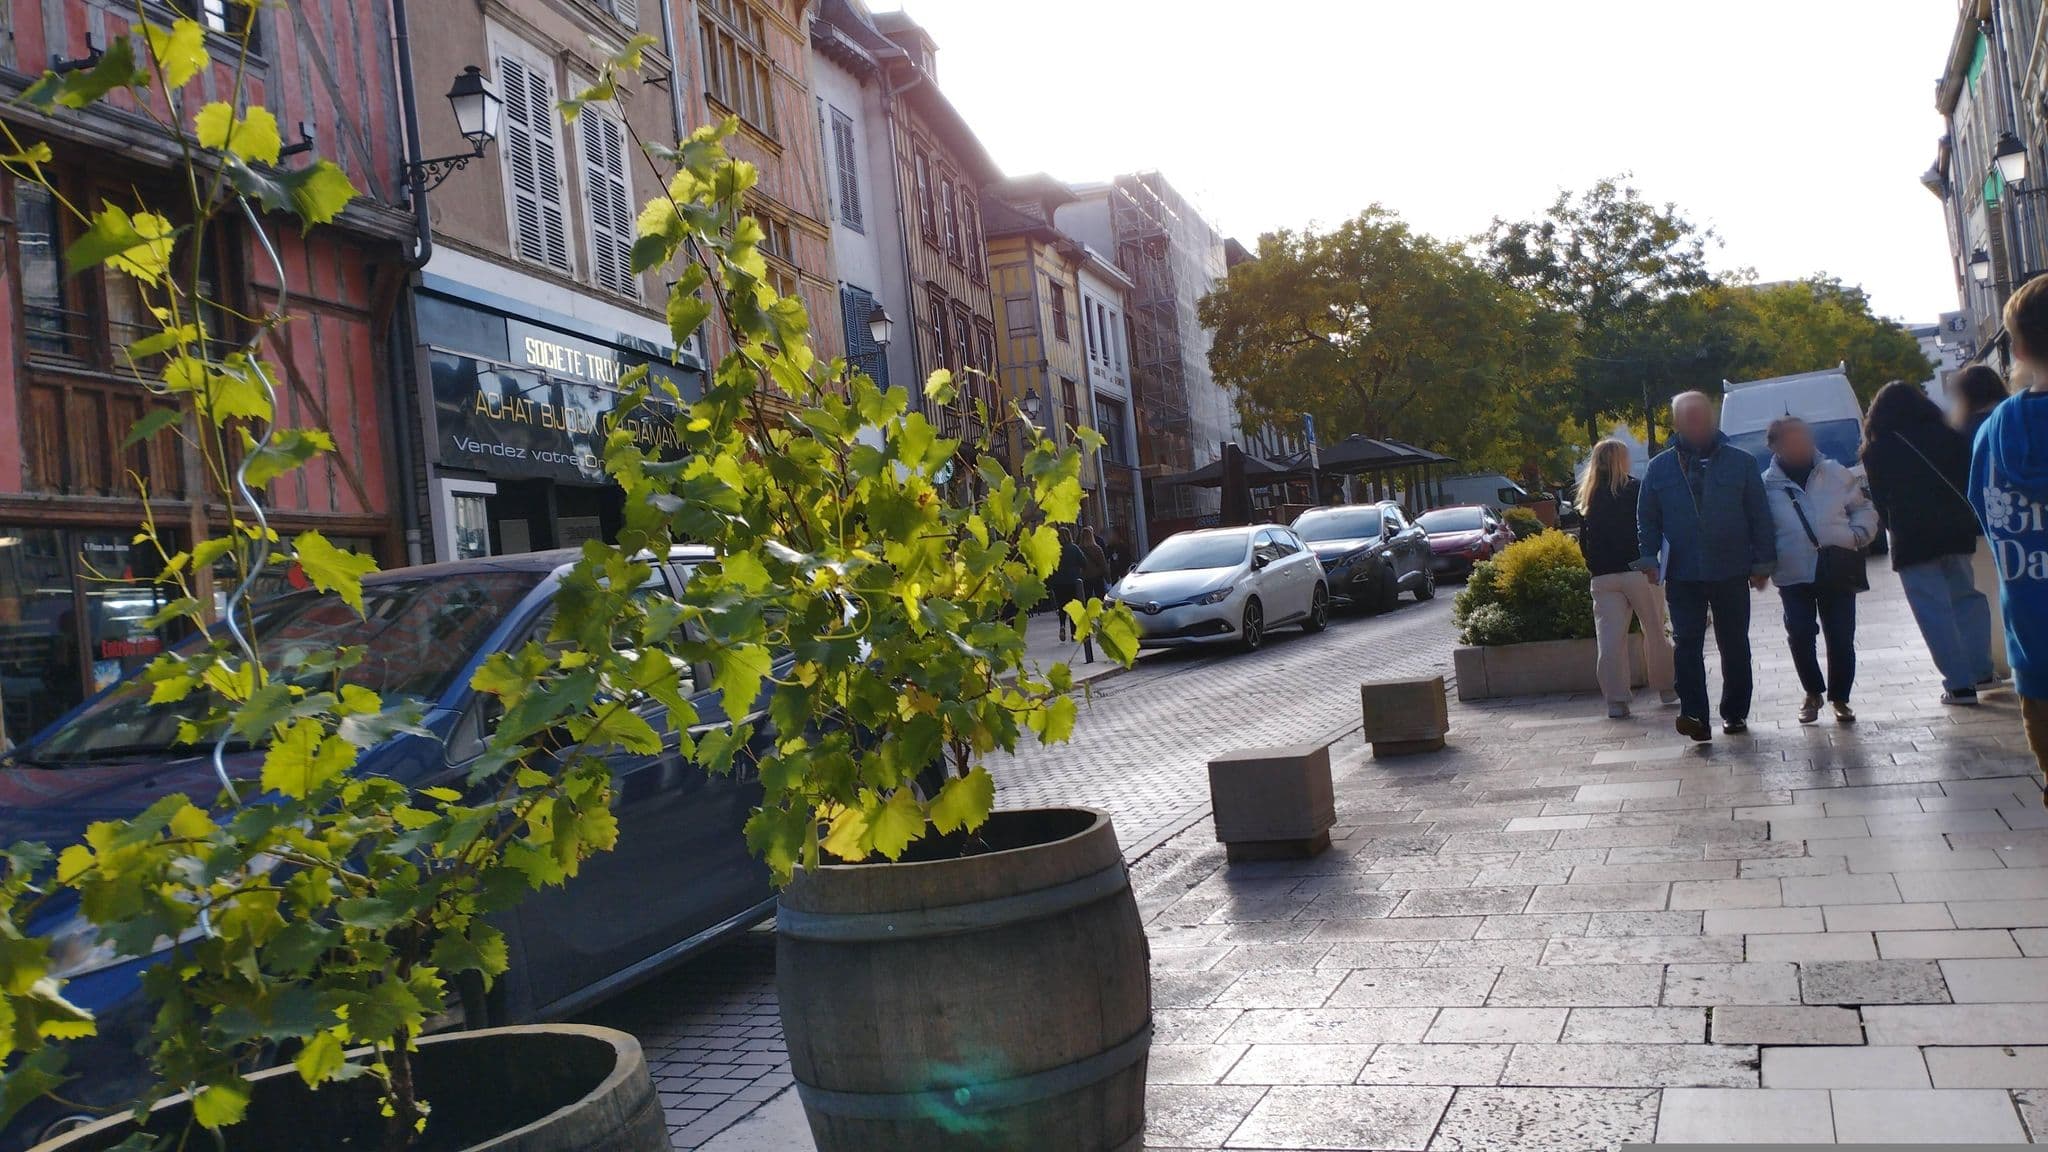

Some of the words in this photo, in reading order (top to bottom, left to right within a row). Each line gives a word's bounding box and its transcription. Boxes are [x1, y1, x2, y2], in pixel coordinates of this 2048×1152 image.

[525, 336, 584, 377] SOCIETE
[585, 353, 620, 385] TROY
[475, 389, 535, 425] ACHAT
[540, 403, 600, 436] BIJOUX
[452, 435, 527, 460] Vendez
[531, 449, 579, 466] votre
